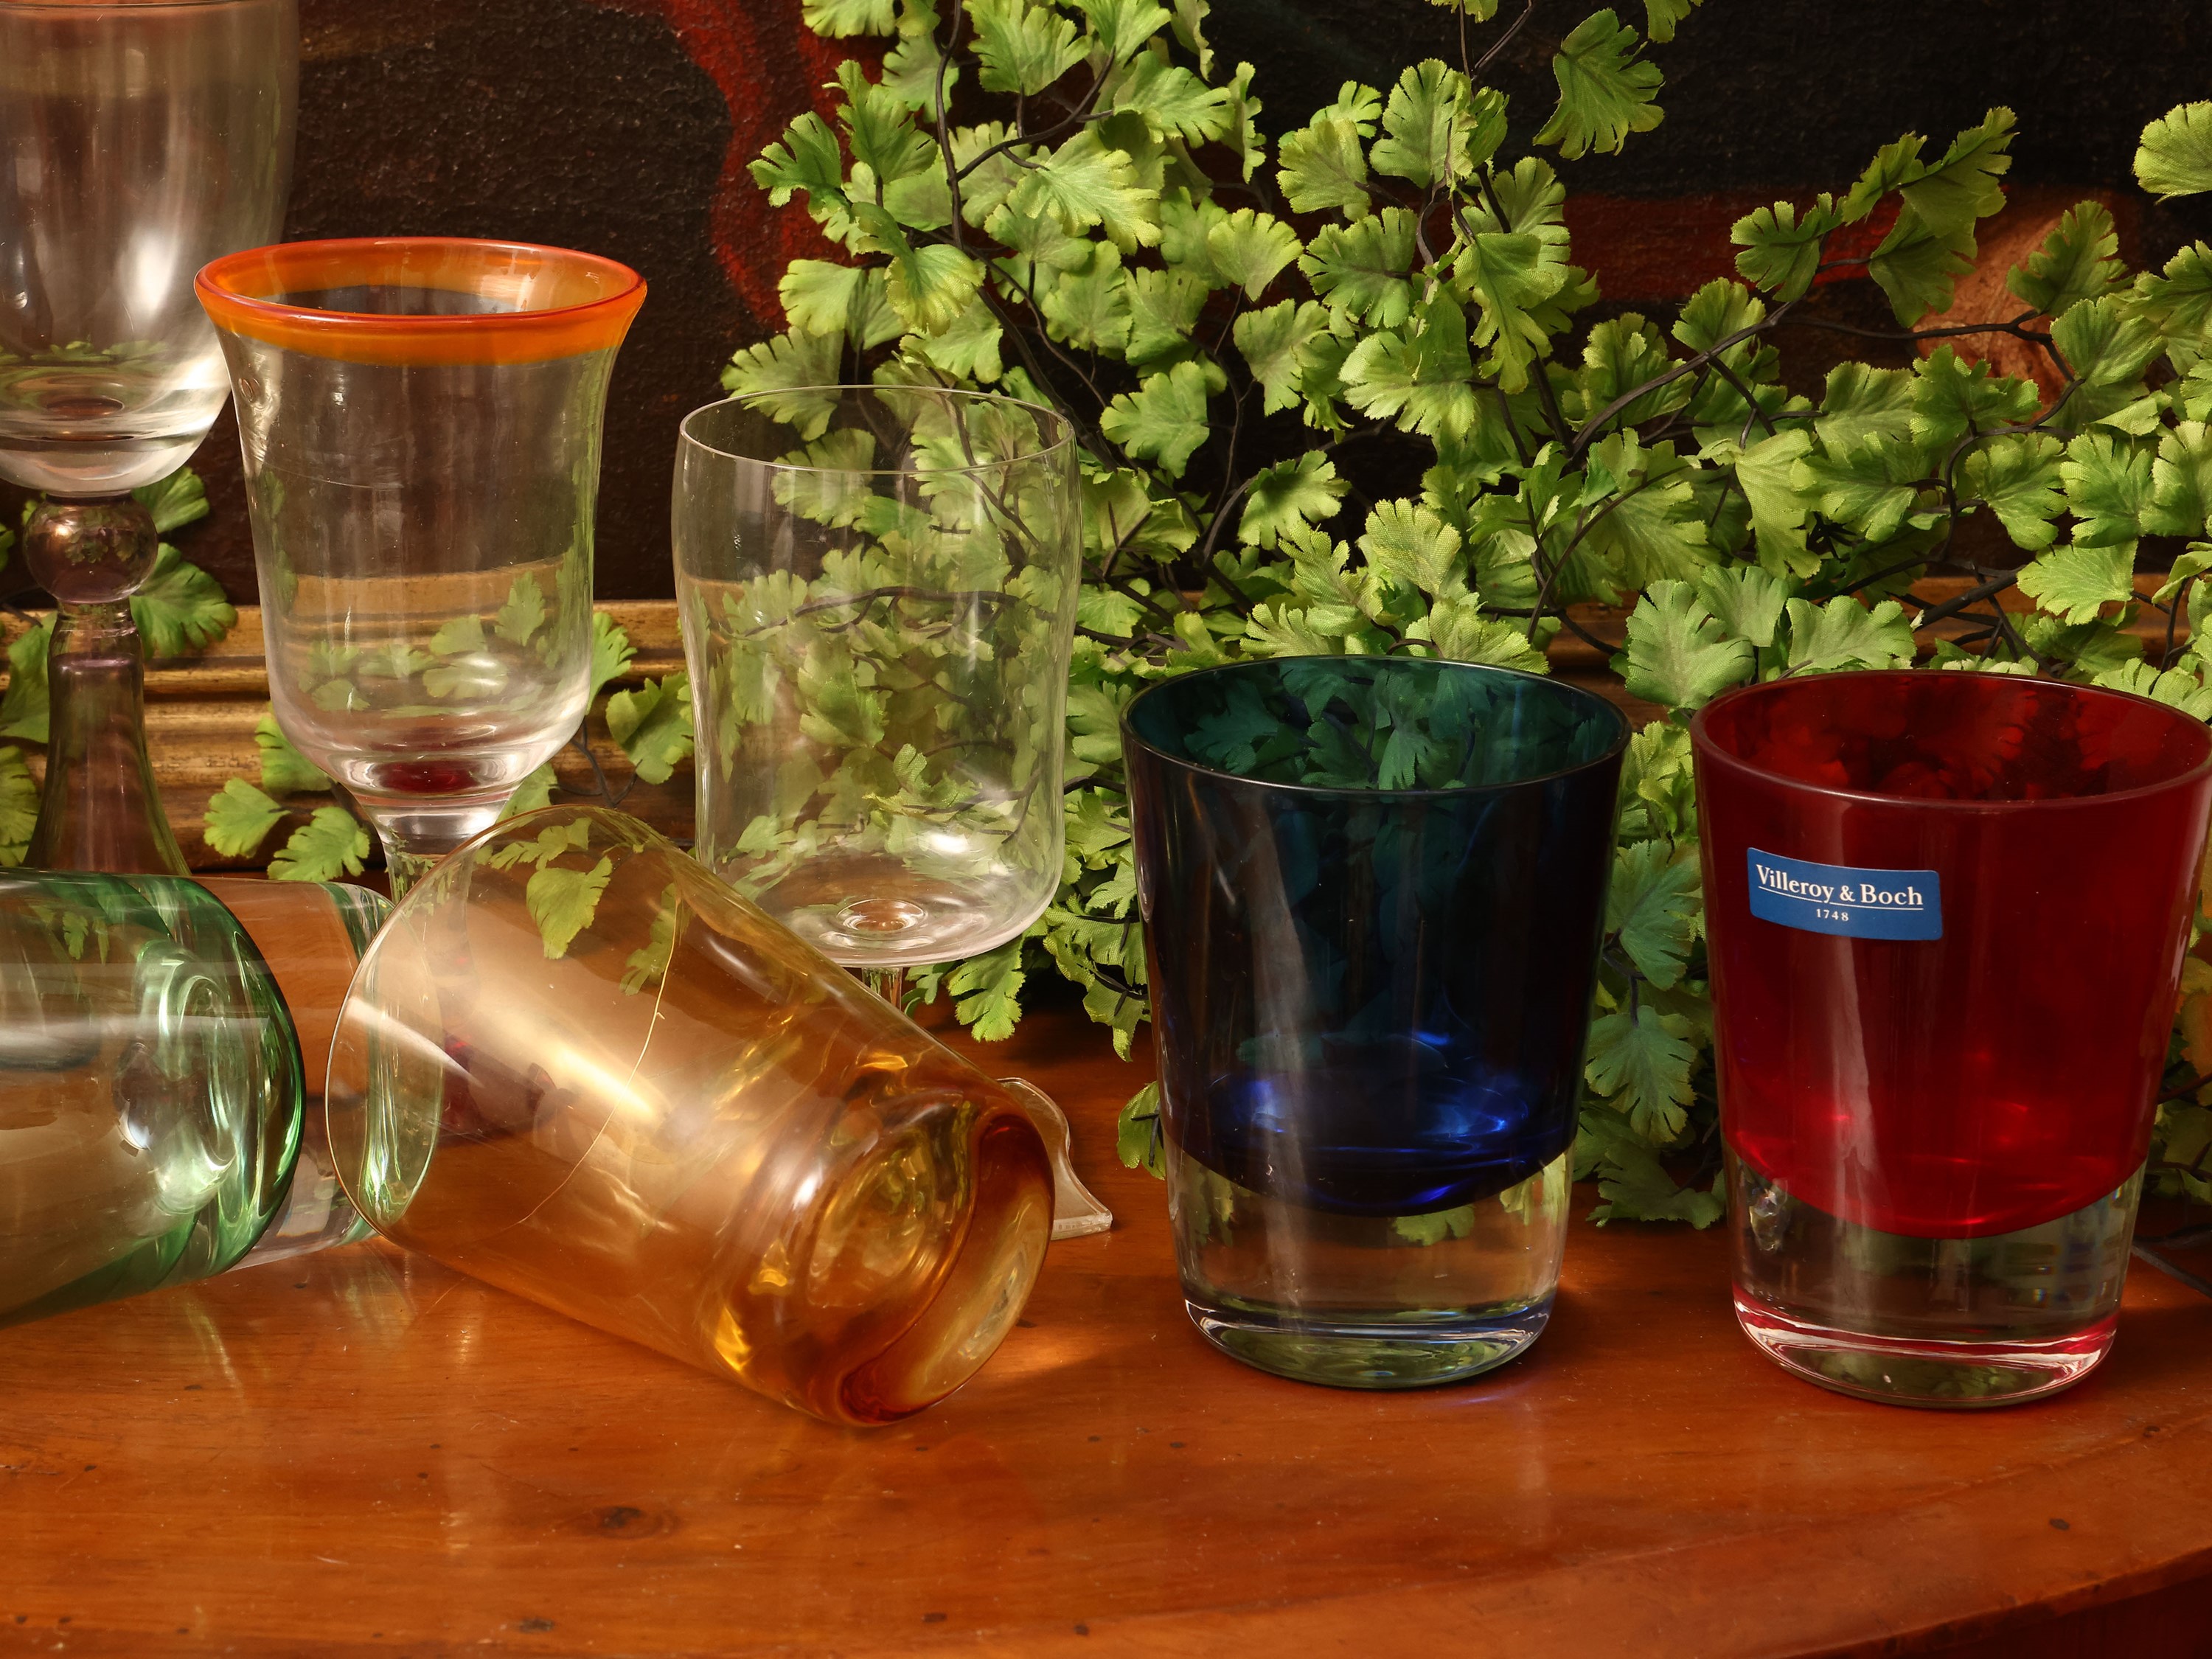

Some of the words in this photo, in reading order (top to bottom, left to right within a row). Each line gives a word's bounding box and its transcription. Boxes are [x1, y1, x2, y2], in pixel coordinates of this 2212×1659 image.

[1756, 863, 1835, 903] Villeroy
[1839, 885, 1856, 902] &
[1860, 883, 1924, 905] Boch
[1816, 908, 1849, 922] 1748
